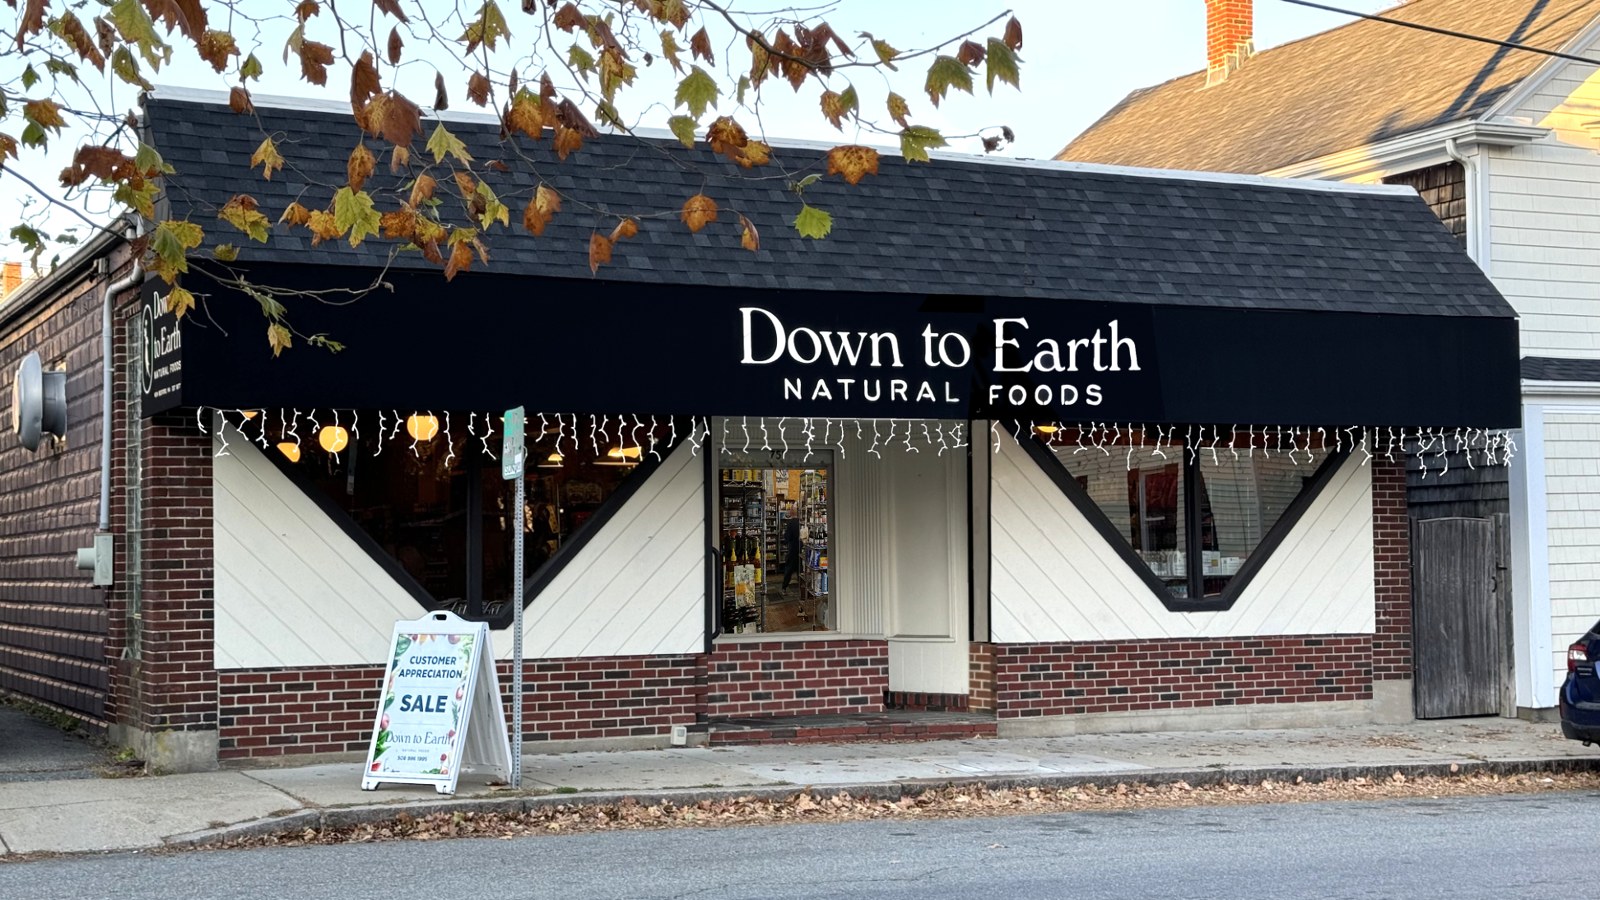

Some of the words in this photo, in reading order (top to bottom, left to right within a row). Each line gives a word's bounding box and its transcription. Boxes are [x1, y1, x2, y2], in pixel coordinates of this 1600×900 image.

[154, 291, 168, 319] Dow
[161, 320, 181, 355] Earth
[739, 306, 904, 367] Down
[922, 322, 971, 368] to
[992, 317, 1142, 373] Earth
[784, 377, 960, 403] NATURAL
[989, 384, 1103, 406] FOODS
[409, 656, 457, 665] CUSTOMER
[398, 669, 463, 678] APPRECIATION
[399, 694, 449, 713] SALE
[385, 731, 411, 744] Down
[412, 734, 422, 744] to
[424, 731, 451, 745] Earth
